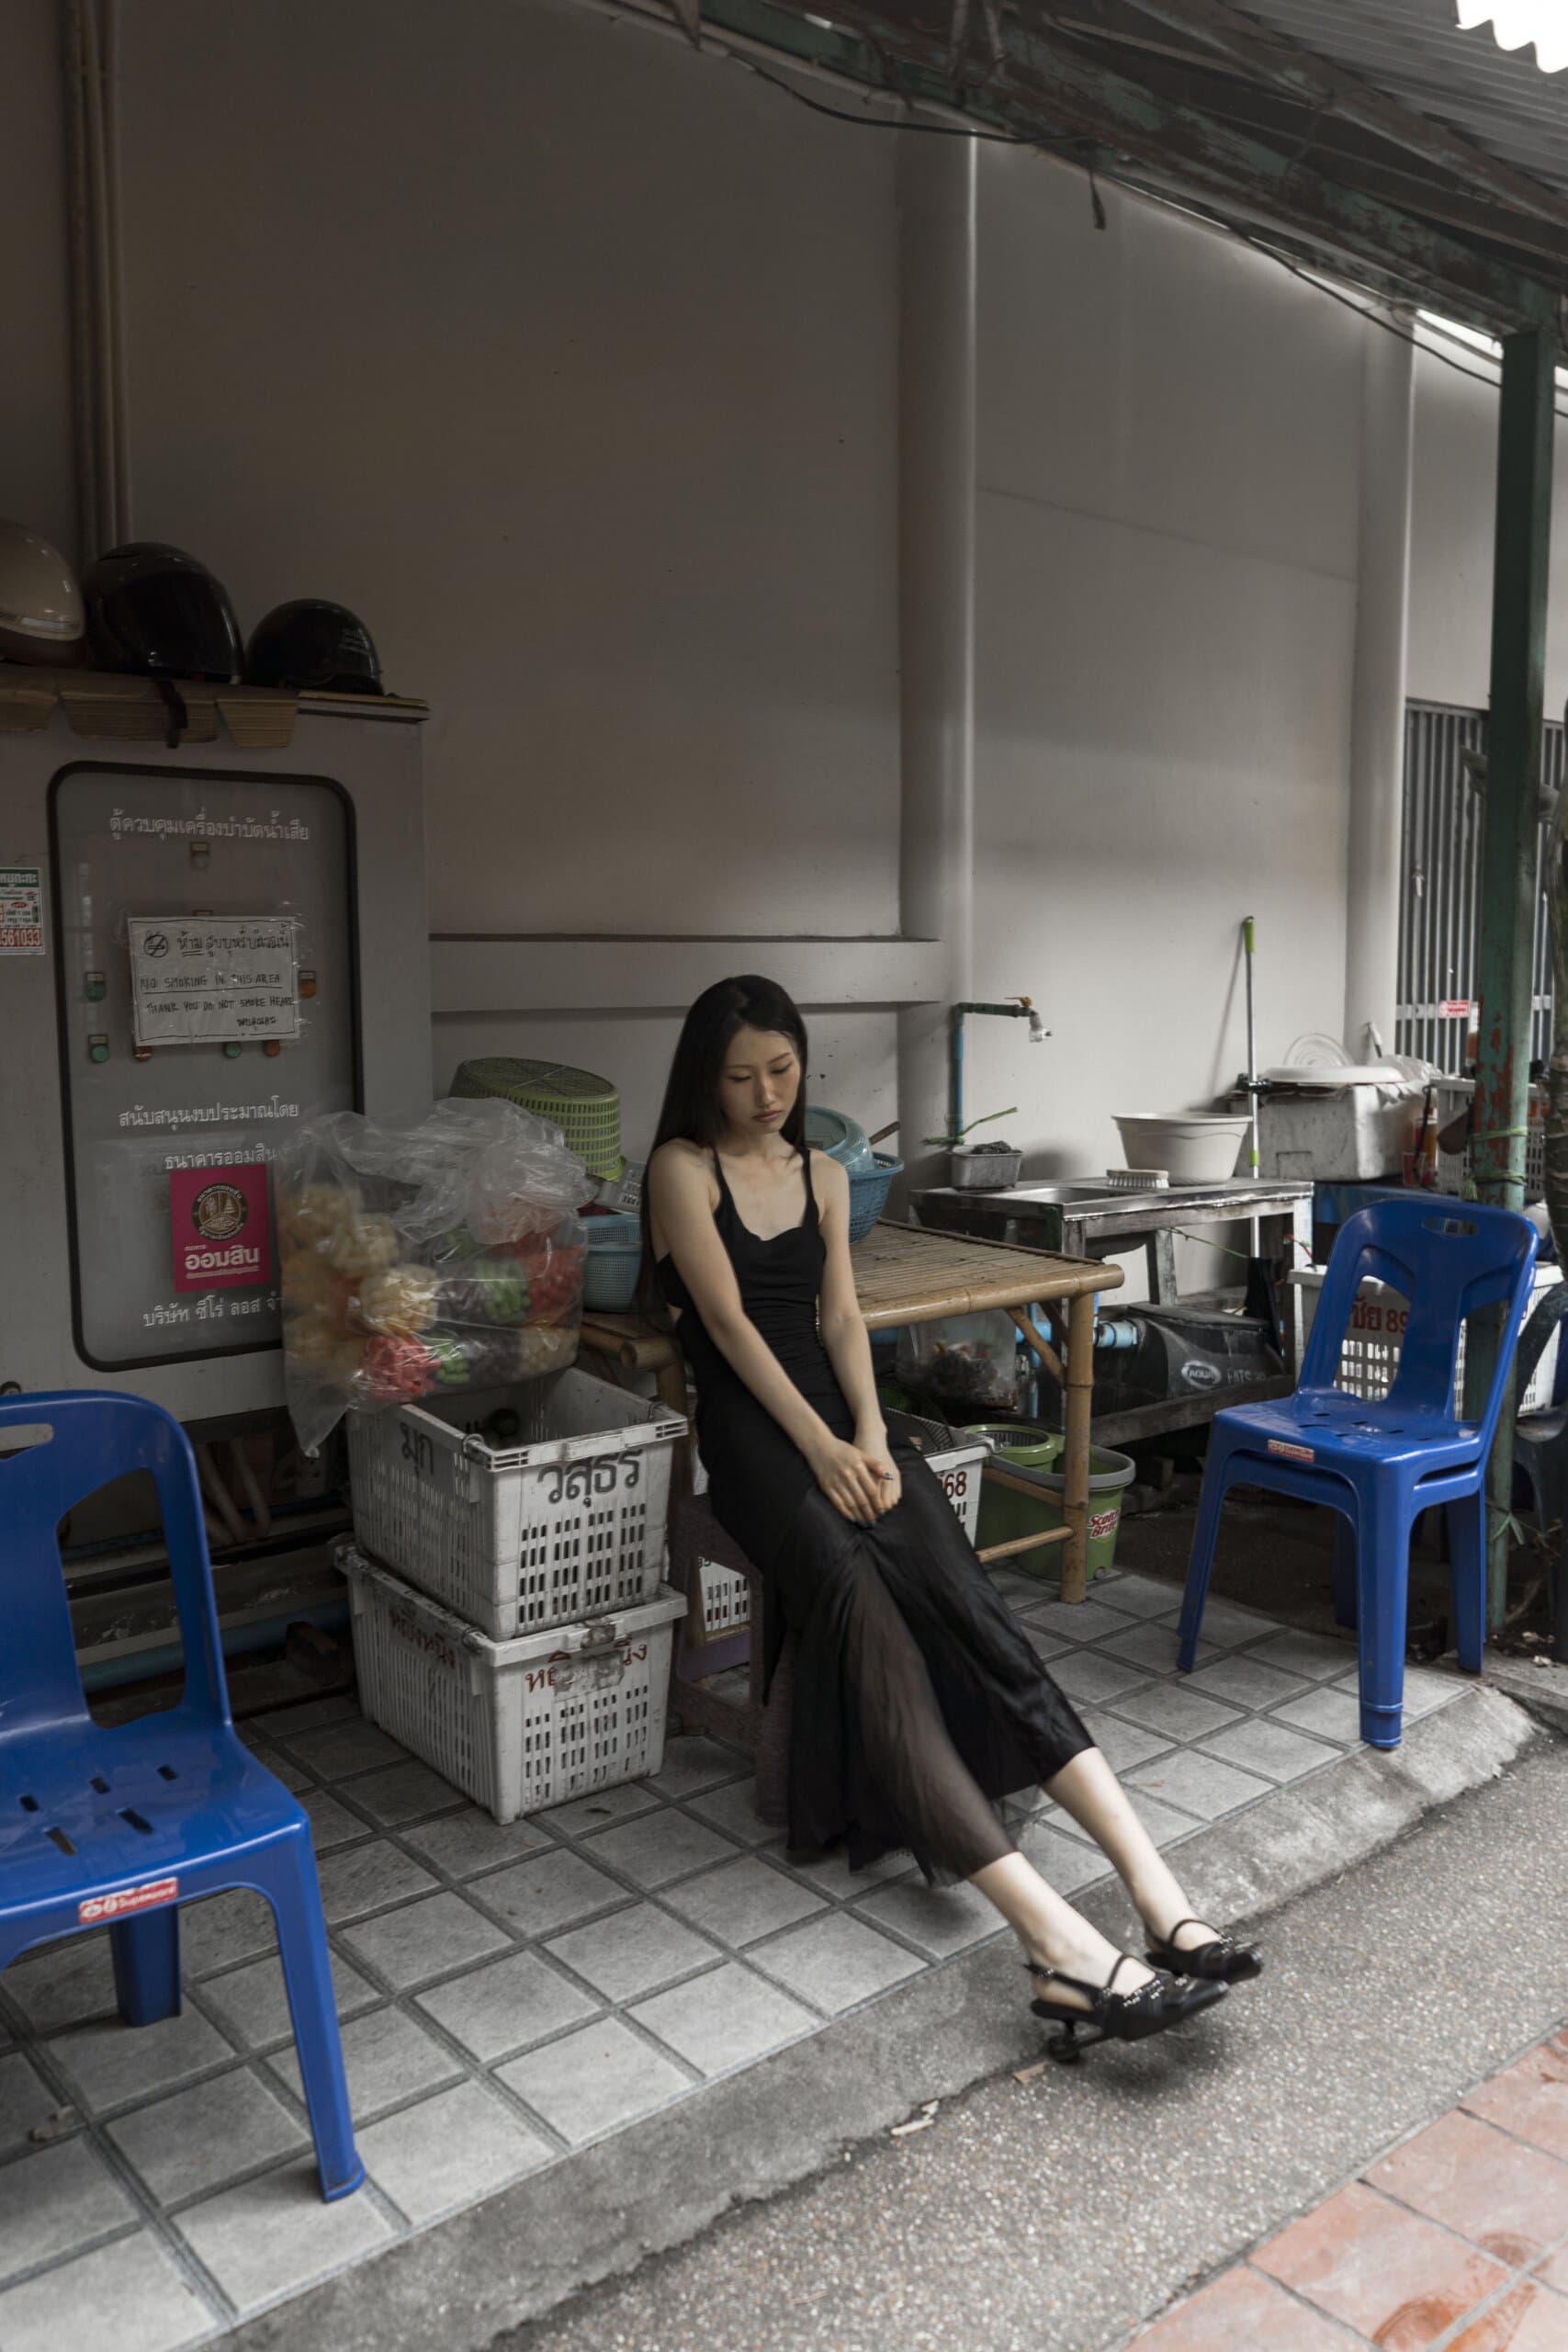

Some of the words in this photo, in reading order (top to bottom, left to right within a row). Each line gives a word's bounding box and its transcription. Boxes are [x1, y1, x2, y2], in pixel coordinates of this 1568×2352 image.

[0, 929, 40, 945] 561033
[140, 978, 156, 989] NO
[164, 976, 208, 989] SMOKING
[215, 974, 224, 985] IN
[255, 974, 279, 985] AREA
[146, 1001, 180, 1013] THANK
[184, 1001, 198, 1012] YOU
[240, 997, 265, 1007] SMOKE
[118, 1095, 299, 1131] สนับสนุนงบประมาณโดย
[185, 1244, 260, 1271] ออมสิน
[142, 1302, 190, 1327] บริษัท
